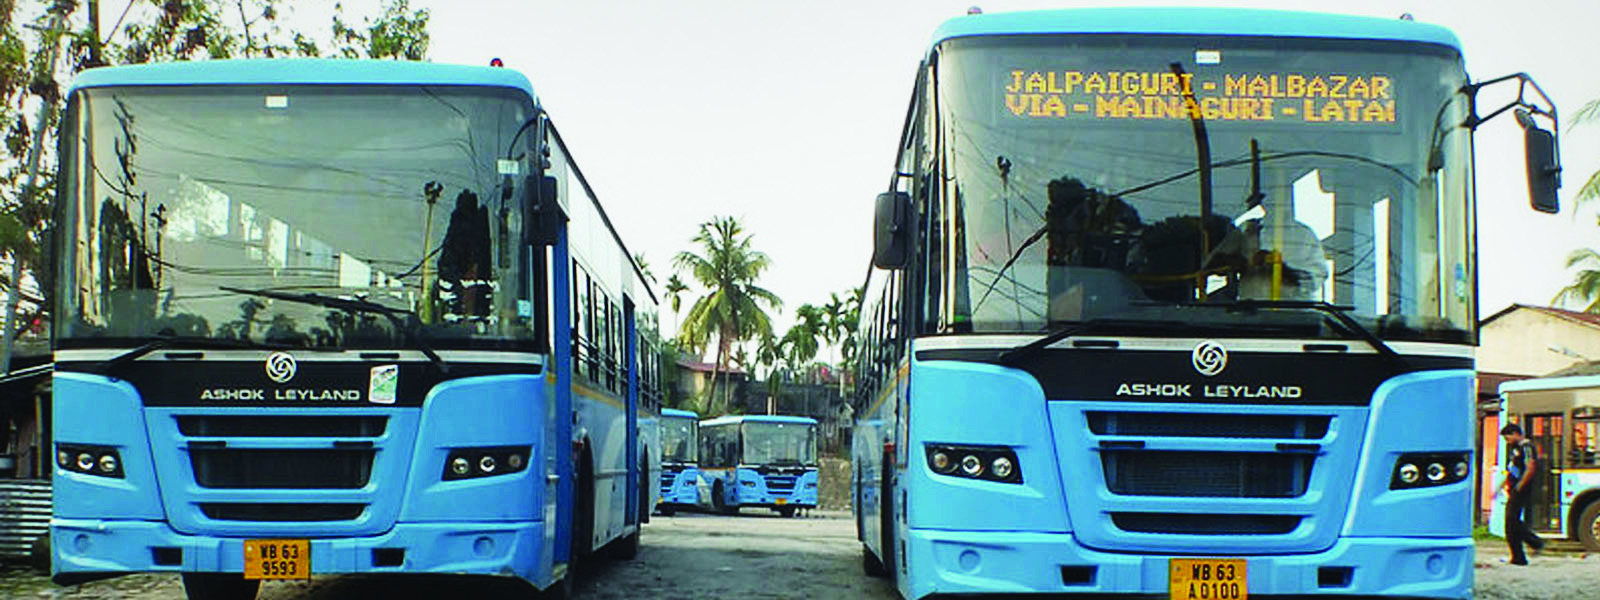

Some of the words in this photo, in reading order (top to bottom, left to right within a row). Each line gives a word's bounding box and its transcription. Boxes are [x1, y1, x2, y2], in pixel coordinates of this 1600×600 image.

[1005, 71, 1194, 96] JALPAIGURI
[1224, 73, 1391, 99] MALBAZAR
[1005, 93, 1066, 118] VIA
[1096, 95, 1274, 120] MAINAGURI
[200, 388, 264, 400] ASHOK
[274, 389, 360, 400] LEYLAND
[1116, 383, 1192, 397] ASHOK
[1204, 385, 1302, 398] LEYLAND
[260, 544, 277, 559] WB
[282, 544, 298, 559] 63
[262, 561, 297, 576] 9593
[1192, 564, 1210, 581] WB
[1216, 564, 1235, 581] 63
